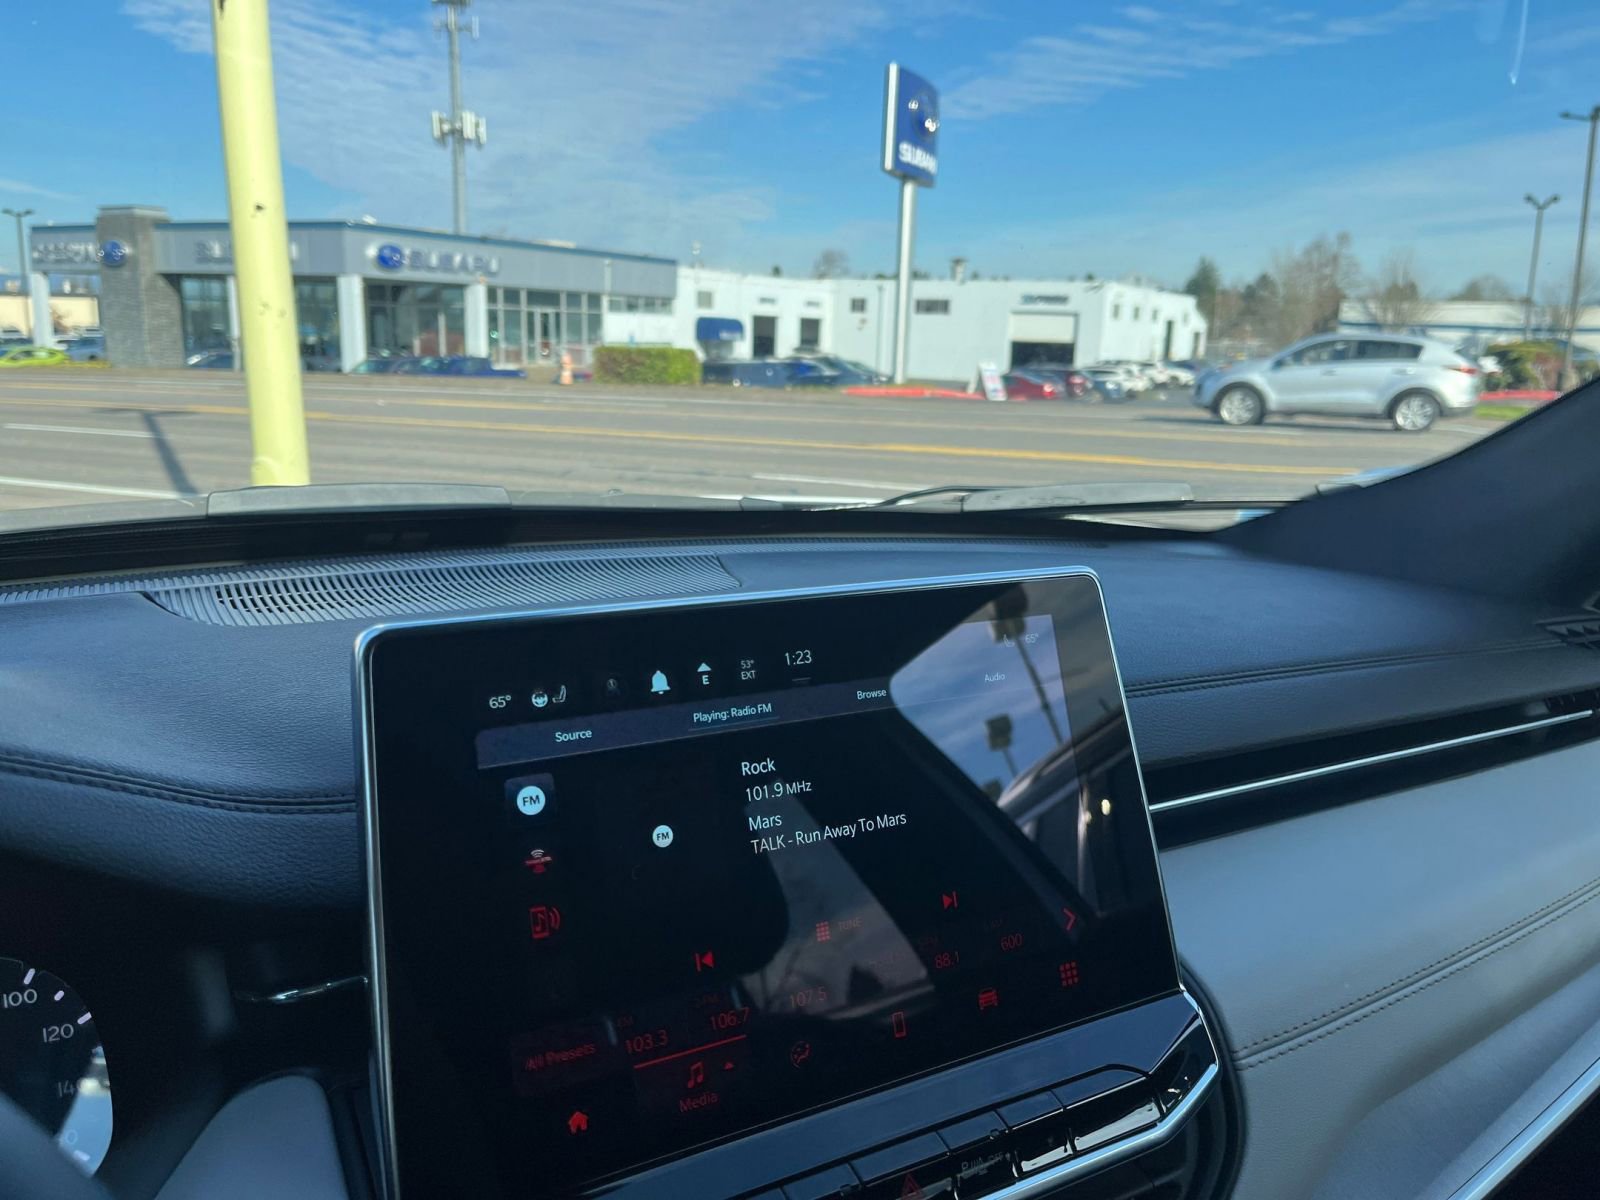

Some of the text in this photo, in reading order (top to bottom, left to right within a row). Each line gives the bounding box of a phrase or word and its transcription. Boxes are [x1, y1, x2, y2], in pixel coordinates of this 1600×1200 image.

[740, 659, 755, 670] 53°
[785, 650, 812, 666] 1:23
[702, 675, 710, 685] E
[741, 670, 756, 681] EXT
[984, 672, 1006, 683] Audio
[489, 695, 512, 709] 65°
[857, 688, 887, 700] Browse
[693, 703, 772, 724] Playing: Radio FM
[555, 729, 592, 743] Source
[741, 758, 776, 776] Rock
[746, 780, 812, 803] 101.9 MHz
[522, 794, 541, 808] FM
[748, 814, 782, 832] Mars
[655, 831, 671, 842] FM
[750, 836, 786, 855] TALK
[795, 829, 821, 845] Run
[823, 822, 857, 841] Away
[858, 818, 875, 833] To
[877, 812, 907, 829] Mars
[3, 988, 38, 1009] 100
[710, 1007, 750, 1031] 106.7
[43, 1024, 75, 1043] 120
[625, 1029, 668, 1055] 103.3
[679, 1092, 718, 1113] Media
